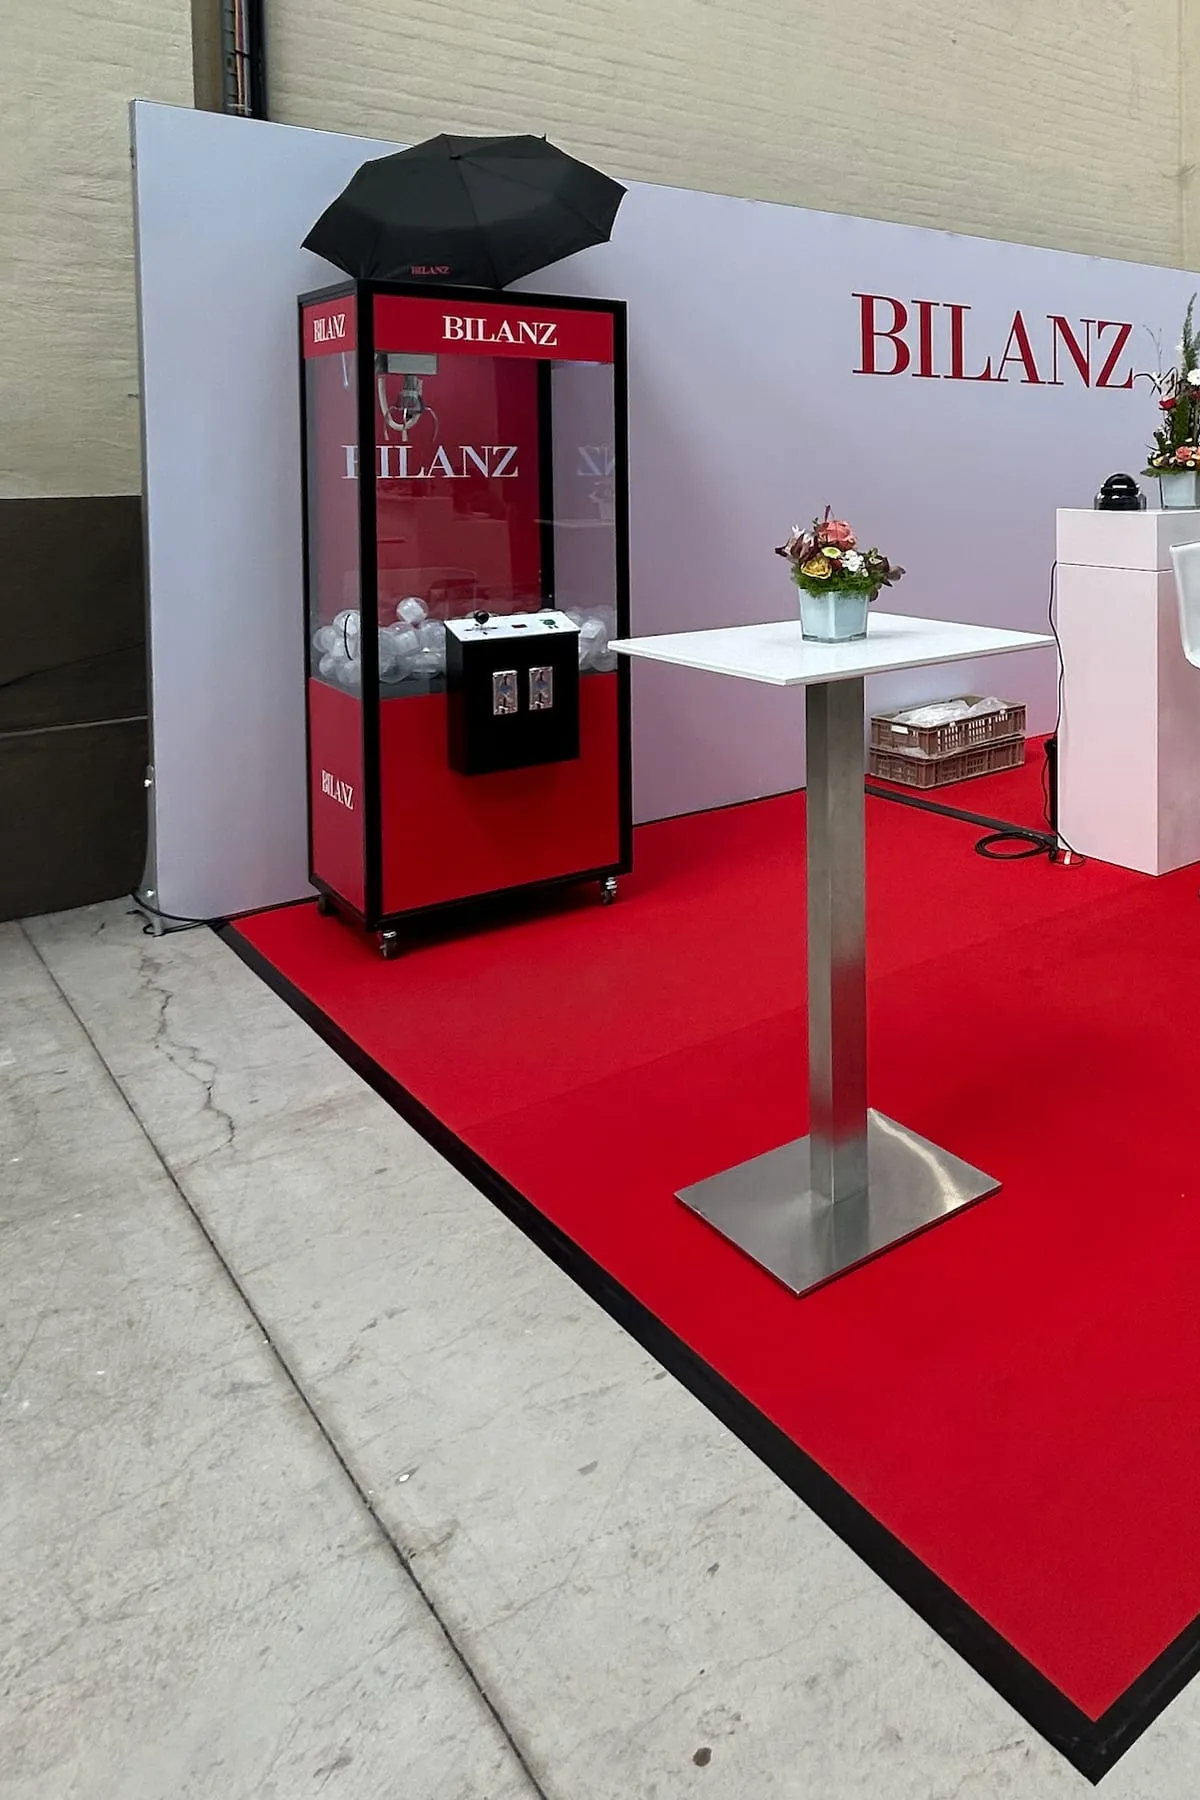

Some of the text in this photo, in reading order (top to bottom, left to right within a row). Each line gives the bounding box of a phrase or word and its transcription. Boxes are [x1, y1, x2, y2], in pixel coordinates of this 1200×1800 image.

[410, 264, 451, 275] BILANZ
[312, 313, 346, 343] BILANZ
[441, 315, 558, 346] BILANZ
[851, 292, 1134, 389] BILANZ
[321, 769, 354, 811] BILANZ
